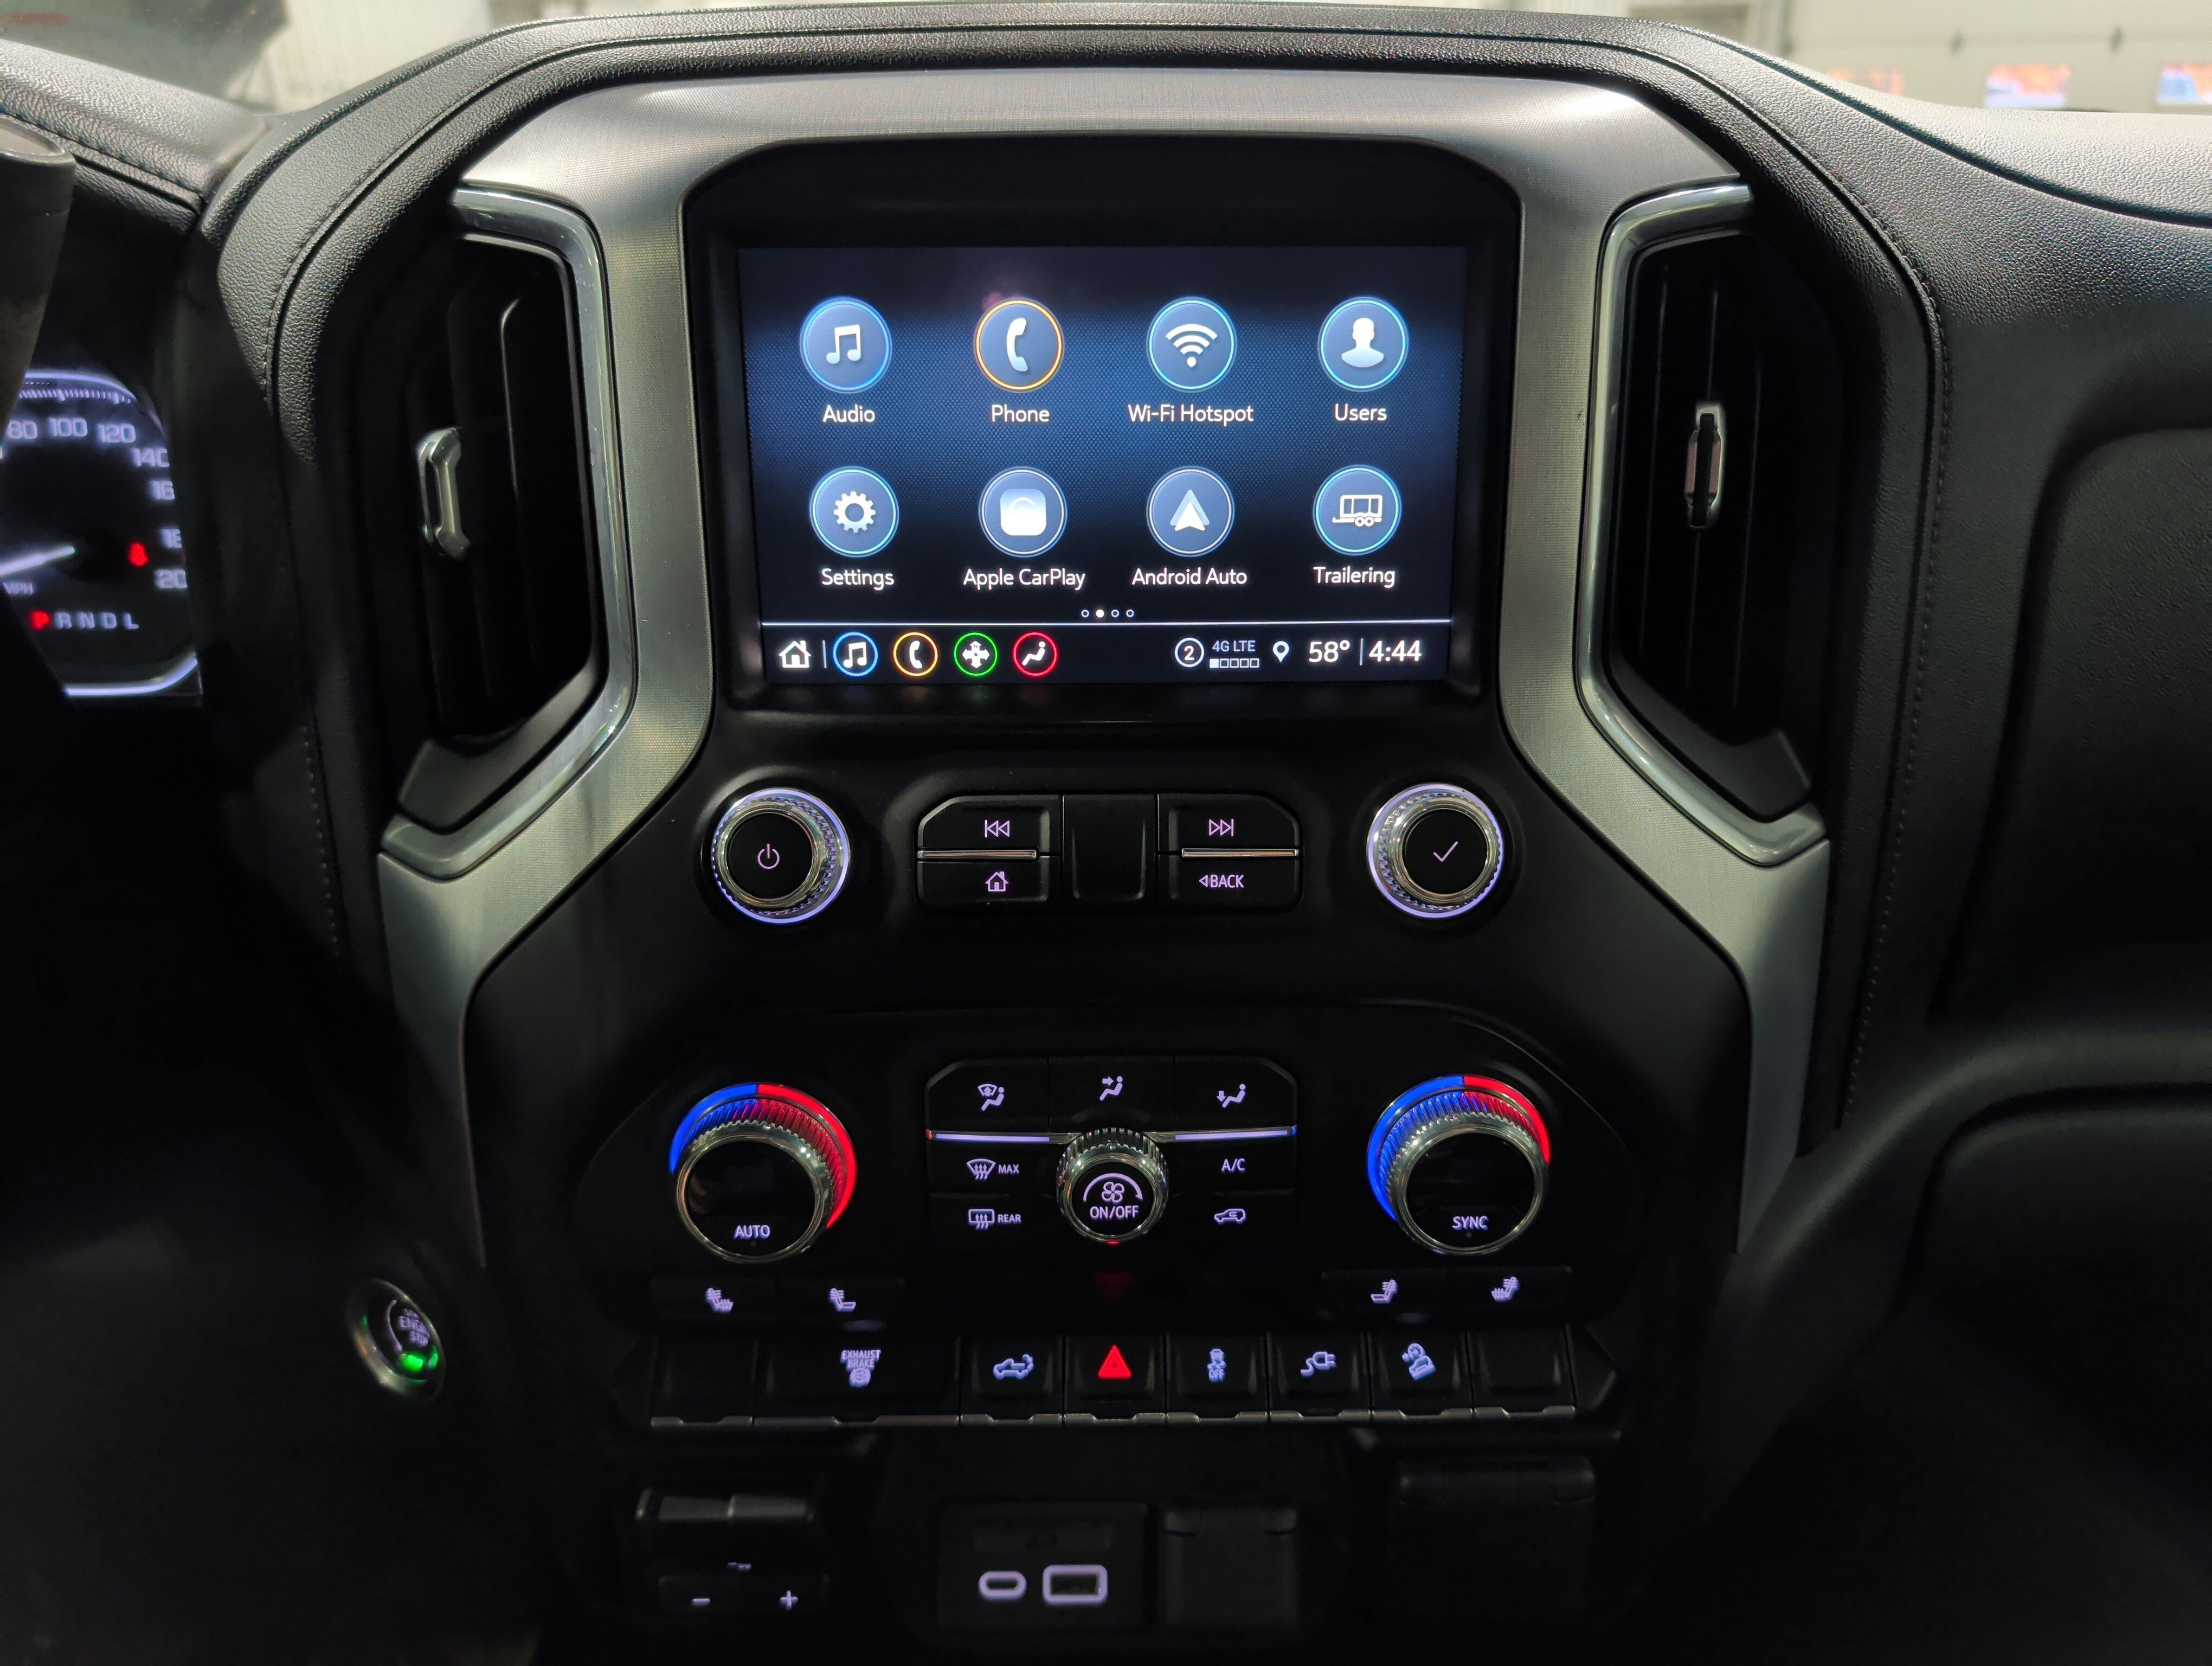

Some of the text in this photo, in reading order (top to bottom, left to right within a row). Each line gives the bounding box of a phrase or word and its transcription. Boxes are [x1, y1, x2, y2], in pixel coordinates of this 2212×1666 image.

[822, 404, 876, 423] Audio
[991, 404, 1050, 422] Phone
[1128, 404, 1254, 426] Wi-Fi Hotspot
[1334, 403, 1387, 421] Users
[7, 420, 37, 439] 80
[48, 417, 88, 437] 100
[98, 424, 136, 444] 120
[151, 480, 175, 500] 16
[821, 567, 895, 591] Settings
[963, 567, 1086, 591] Apple CarPlay
[1131, 567, 1248, 585] Android Auto
[1313, 566, 1396, 588] Trailering
[1184, 645, 1195, 661] 2
[1212, 639, 1256, 652] 4G LTE
[1308, 639, 1351, 663] 58°
[1368, 640, 1423, 662] 4:44
[1210, 874, 1244, 888] BACK
[998, 1164, 1020, 1175] MAX
[1221, 1158, 1246, 1174] A/C
[997, 1214, 1022, 1225] REAR
[1090, 1205, 1139, 1220] ON/OFF
[1452, 1215, 1489, 1231] SYNC
[733, 1225, 770, 1240] AUTO
[840, 1349, 881, 1361] EXHAUST
[847, 1359, 875, 1368] BRAKE
[1208, 1369, 1225, 1382] OFF
